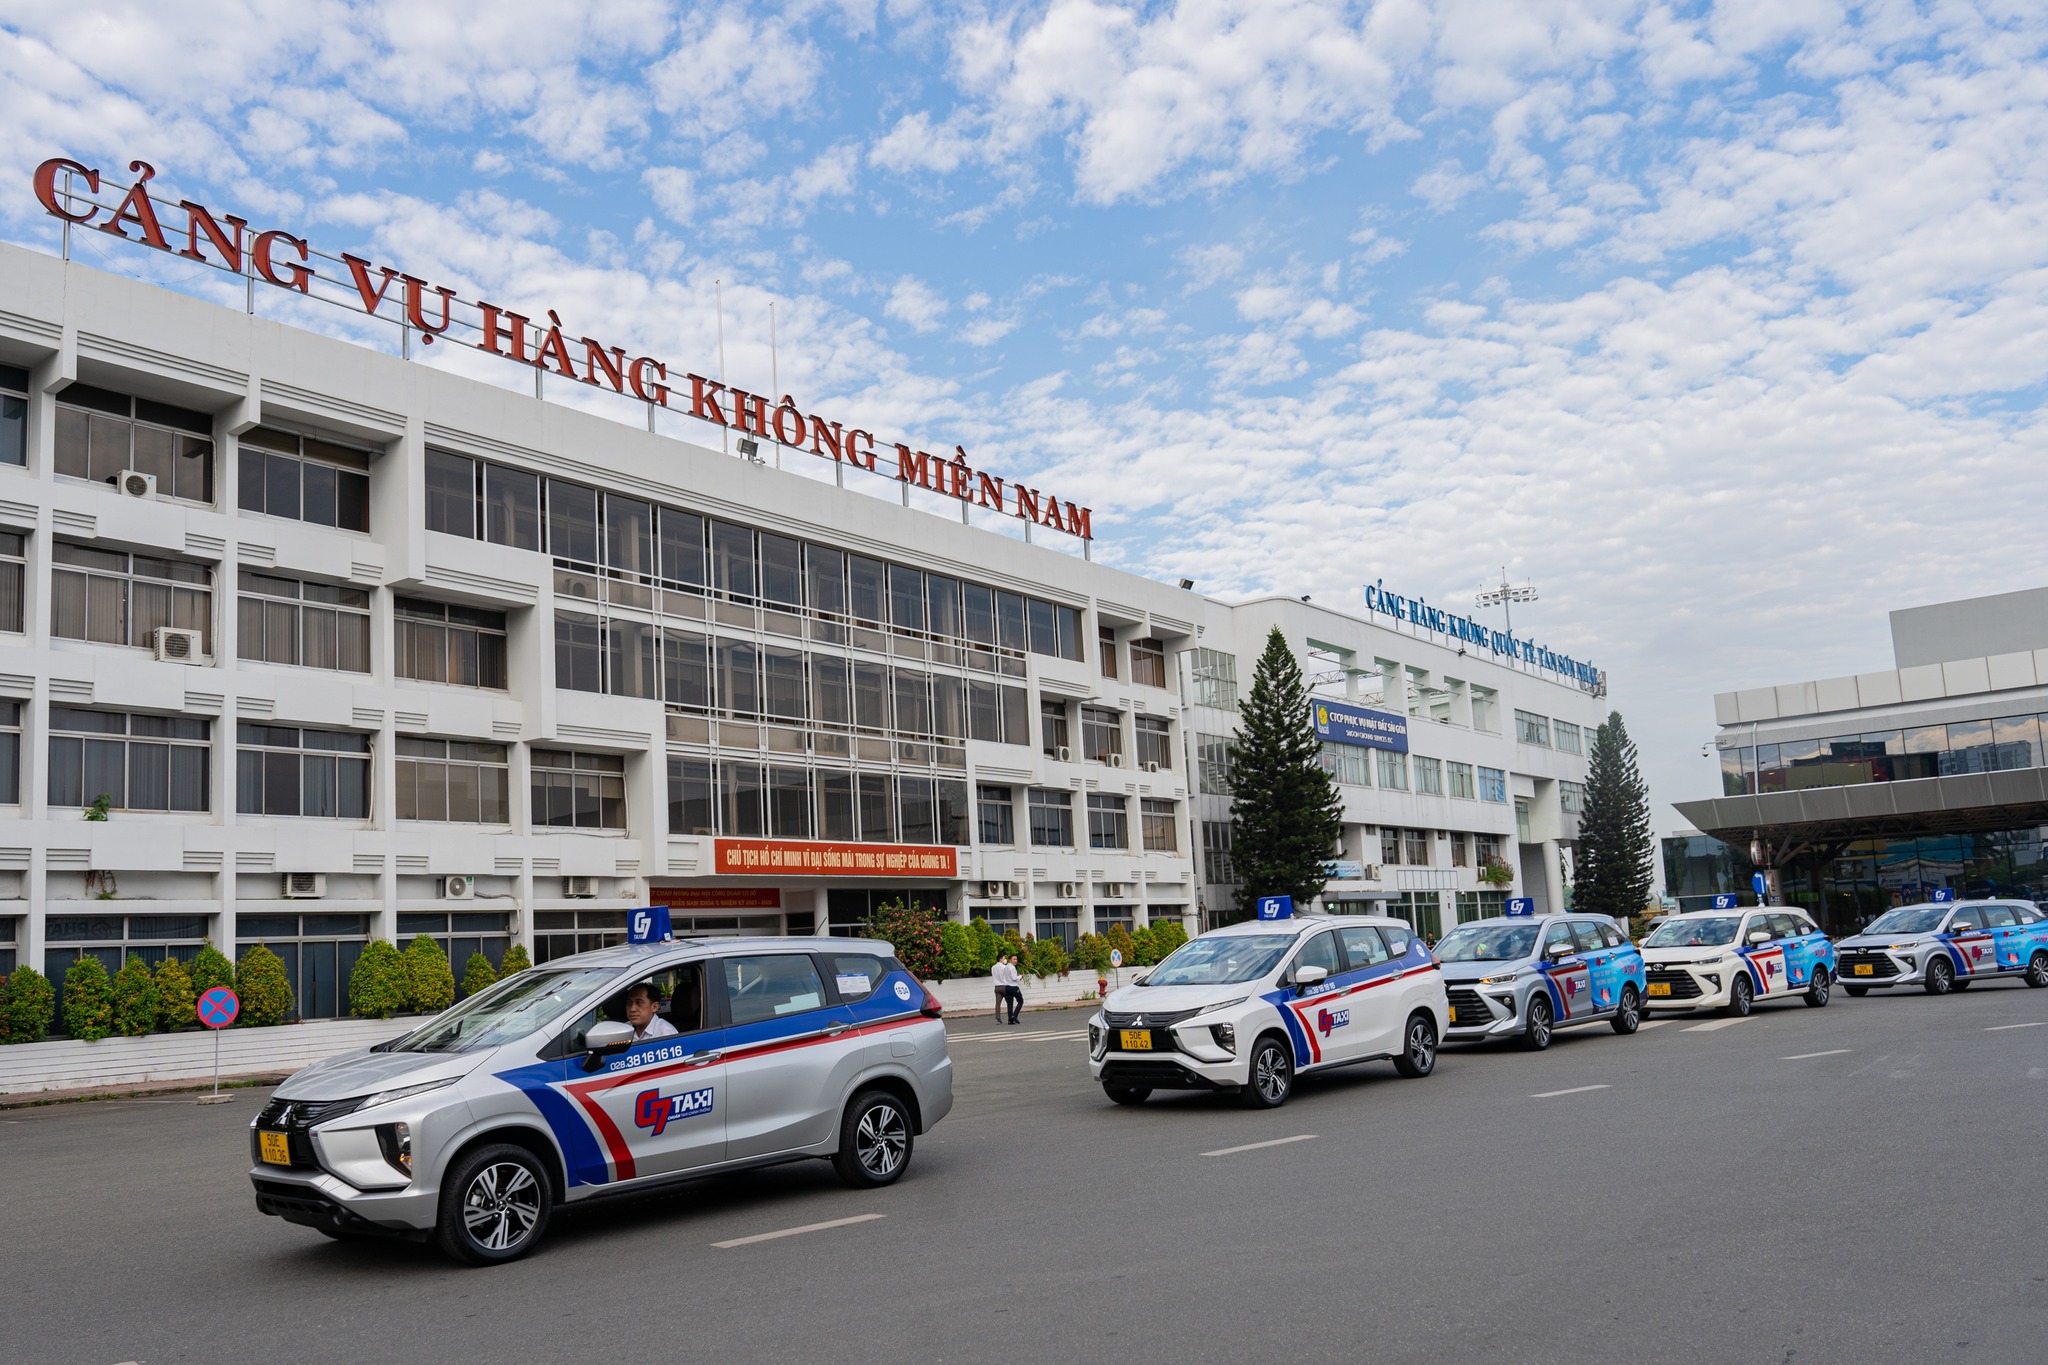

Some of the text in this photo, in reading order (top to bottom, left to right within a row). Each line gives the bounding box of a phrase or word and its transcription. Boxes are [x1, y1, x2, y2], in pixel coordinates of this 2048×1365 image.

[33, 157, 1093, 540] CẢNG VỤ HÀNG KHÔNG MIỀN NAM
[1365, 578, 1405, 620] CẢNG
[1408, 596, 1446, 633] HÀNG
[1448, 613, 1489, 648] KHÔNG
[1491, 629, 1520, 659] QUỐC
[1521, 637, 1536, 664] TẾ
[1536, 644, 1557, 671] TÂN
[727, 844, 741, 866] CHỦ
[743, 849, 759, 869] TỊCH
[771, 847, 783, 866] CHÍ
[784, 850, 802, 867] MINH
[811, 851, 823, 870] ĐẠI
[823, 847, 841, 867] SỐNG
[841, 849, 854, 868] MÃI
[855, 852, 875, 868] TRONG
[876, 852, 885, 871] SỰ
[886, 851, 908, 871] NGHIỆP
[908, 850, 920, 868] CỦA
[920, 852, 939, 869] CHÚNG
[940, 855, 947, 869] TA
[1264, 899, 1280, 918] G7
[1510, 899, 1524, 914] G7
[634, 911, 651, 939] G7
[1332, 1010, 1349, 1025] TAXI
[1125, 1040, 1149, 1048] 110.42
[1128, 1031, 1142, 1039] 50E
[641, 1051, 655, 1064] 16
[655, 1048, 669, 1061] 16
[669, 1045, 683, 1058] 16
[635, 1088, 713, 1137] G7 TAXI
